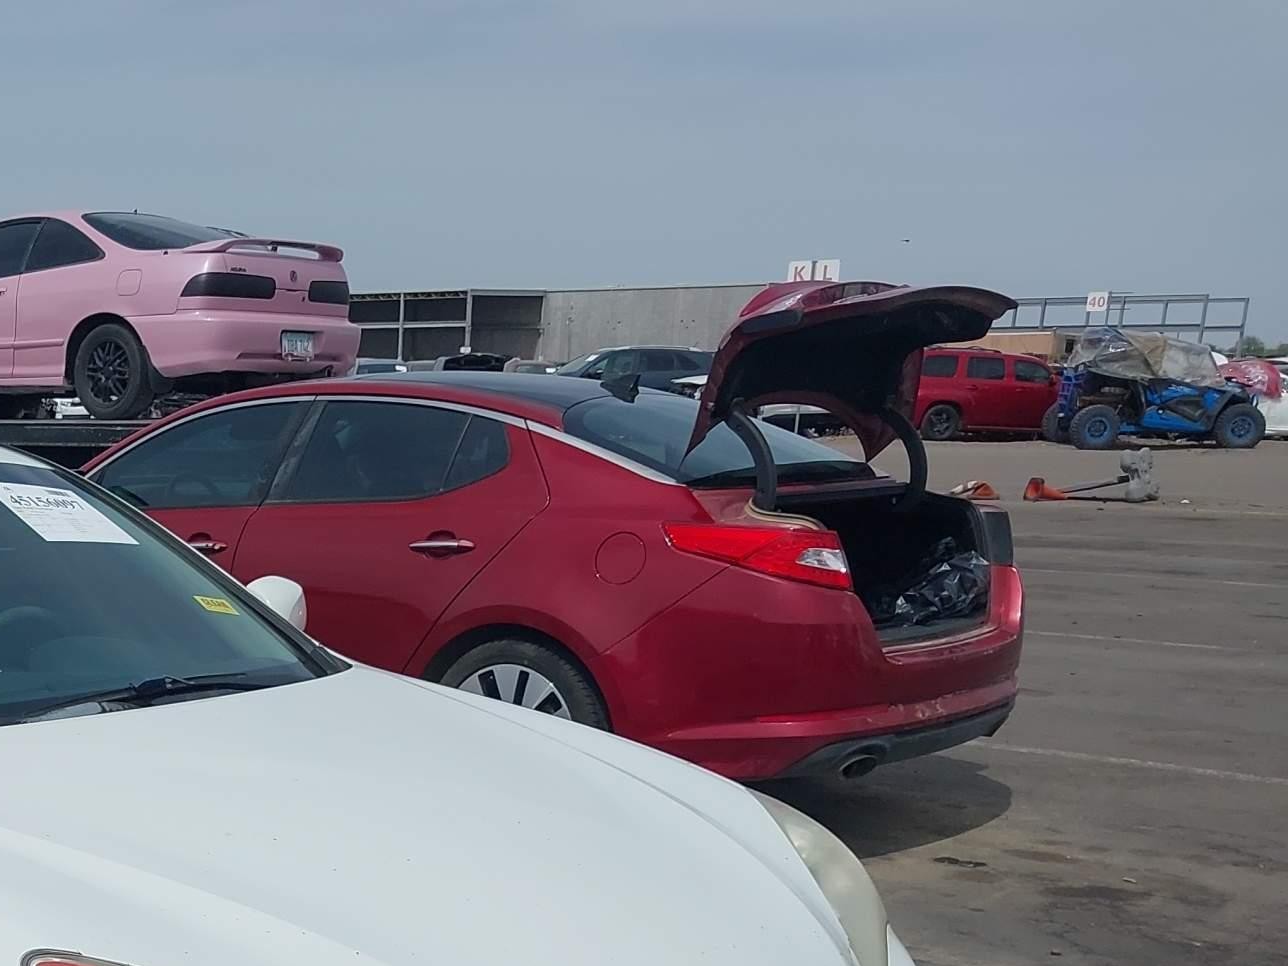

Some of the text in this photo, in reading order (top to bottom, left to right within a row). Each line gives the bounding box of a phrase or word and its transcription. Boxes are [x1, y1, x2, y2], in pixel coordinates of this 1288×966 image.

[794, 264, 833, 281] K L
[1089, 296, 1106, 308] 40
